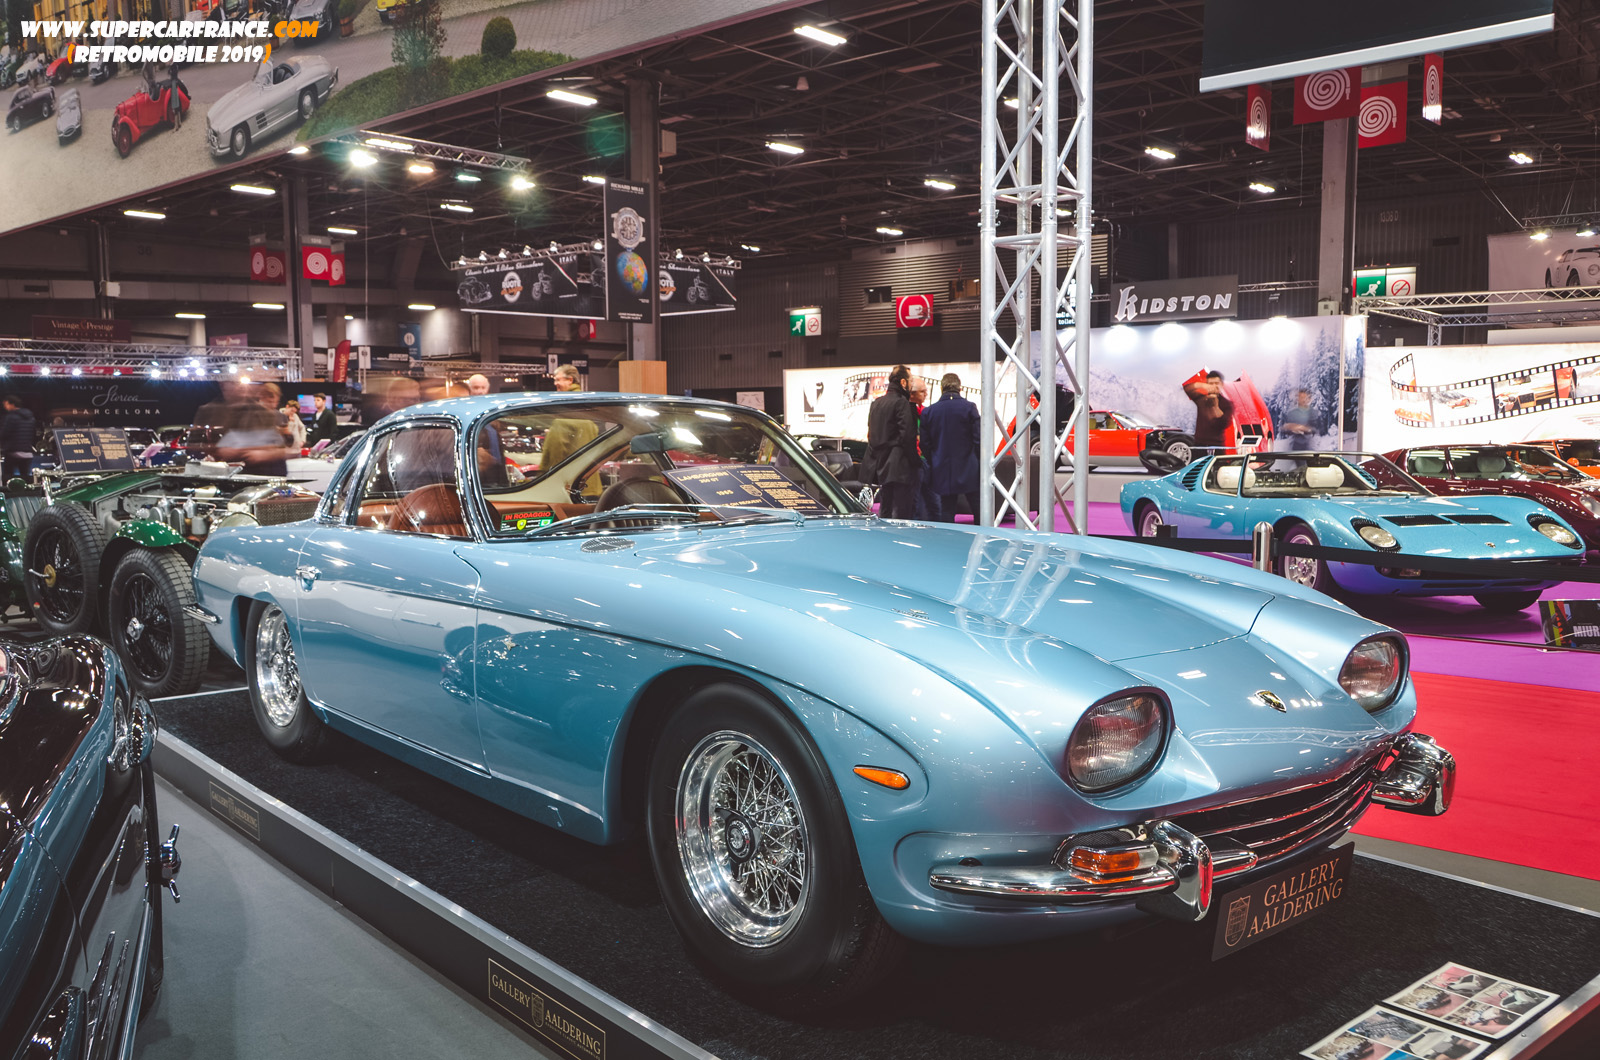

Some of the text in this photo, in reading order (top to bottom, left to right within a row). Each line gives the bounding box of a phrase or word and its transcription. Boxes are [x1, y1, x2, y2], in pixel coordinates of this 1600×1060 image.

[559, 255, 578, 264] ITALY
[716, 268, 735, 276] ITALY
[51, 319, 80, 330] Vintage
[87, 321, 113, 332] Prestige
[91, 384, 159, 407] Storica
[676, 471, 730, 482] LAMBORGHINI
[513, 511, 551, 520] RODAGGIO
[1572, 625, 1600, 638] MIUR
[1263, 857, 1340, 907] GALLERY
[1247, 878, 1344, 939] AALDERING
[491, 974, 601, 1055] GALLERY AALDERING
